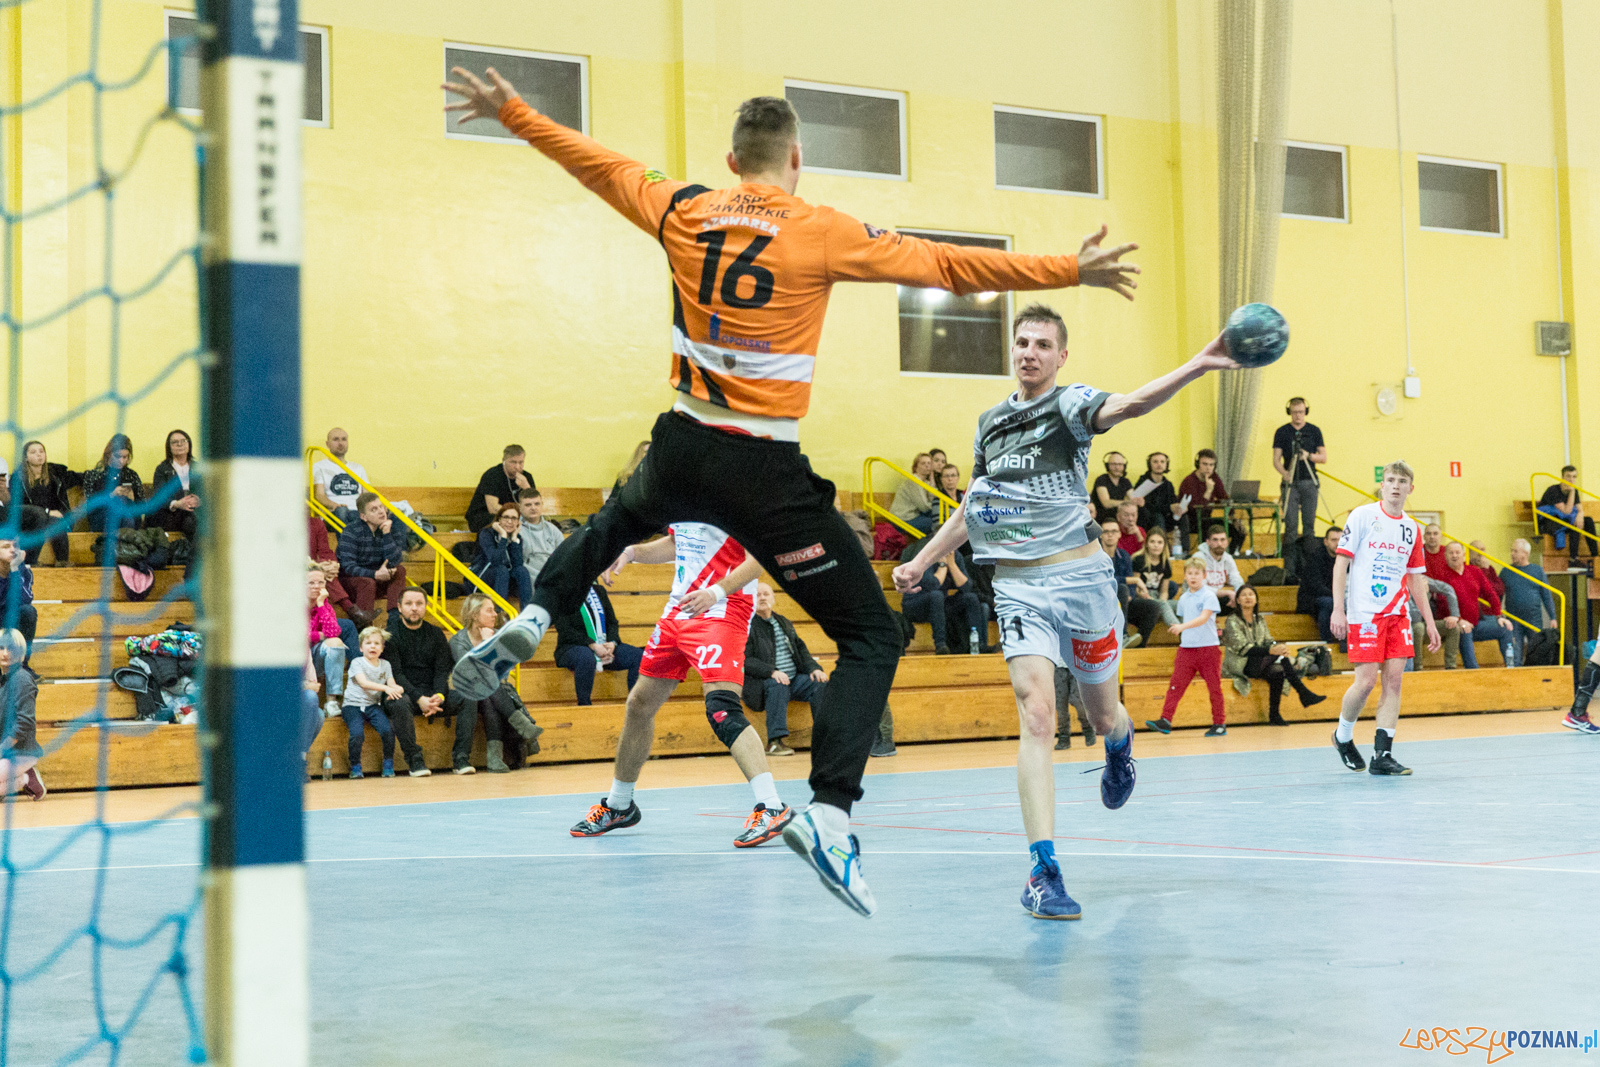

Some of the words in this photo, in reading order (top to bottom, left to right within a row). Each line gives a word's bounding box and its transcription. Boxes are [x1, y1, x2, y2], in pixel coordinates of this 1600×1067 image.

[257, 68, 278, 244] TRANSFER
[696, 230, 775, 309] 16
[721, 334, 771, 350] OPOLSKIE
[984, 523, 1033, 542] netronik
[1400, 523, 1414, 545] 13
[695, 643, 723, 670] 22
